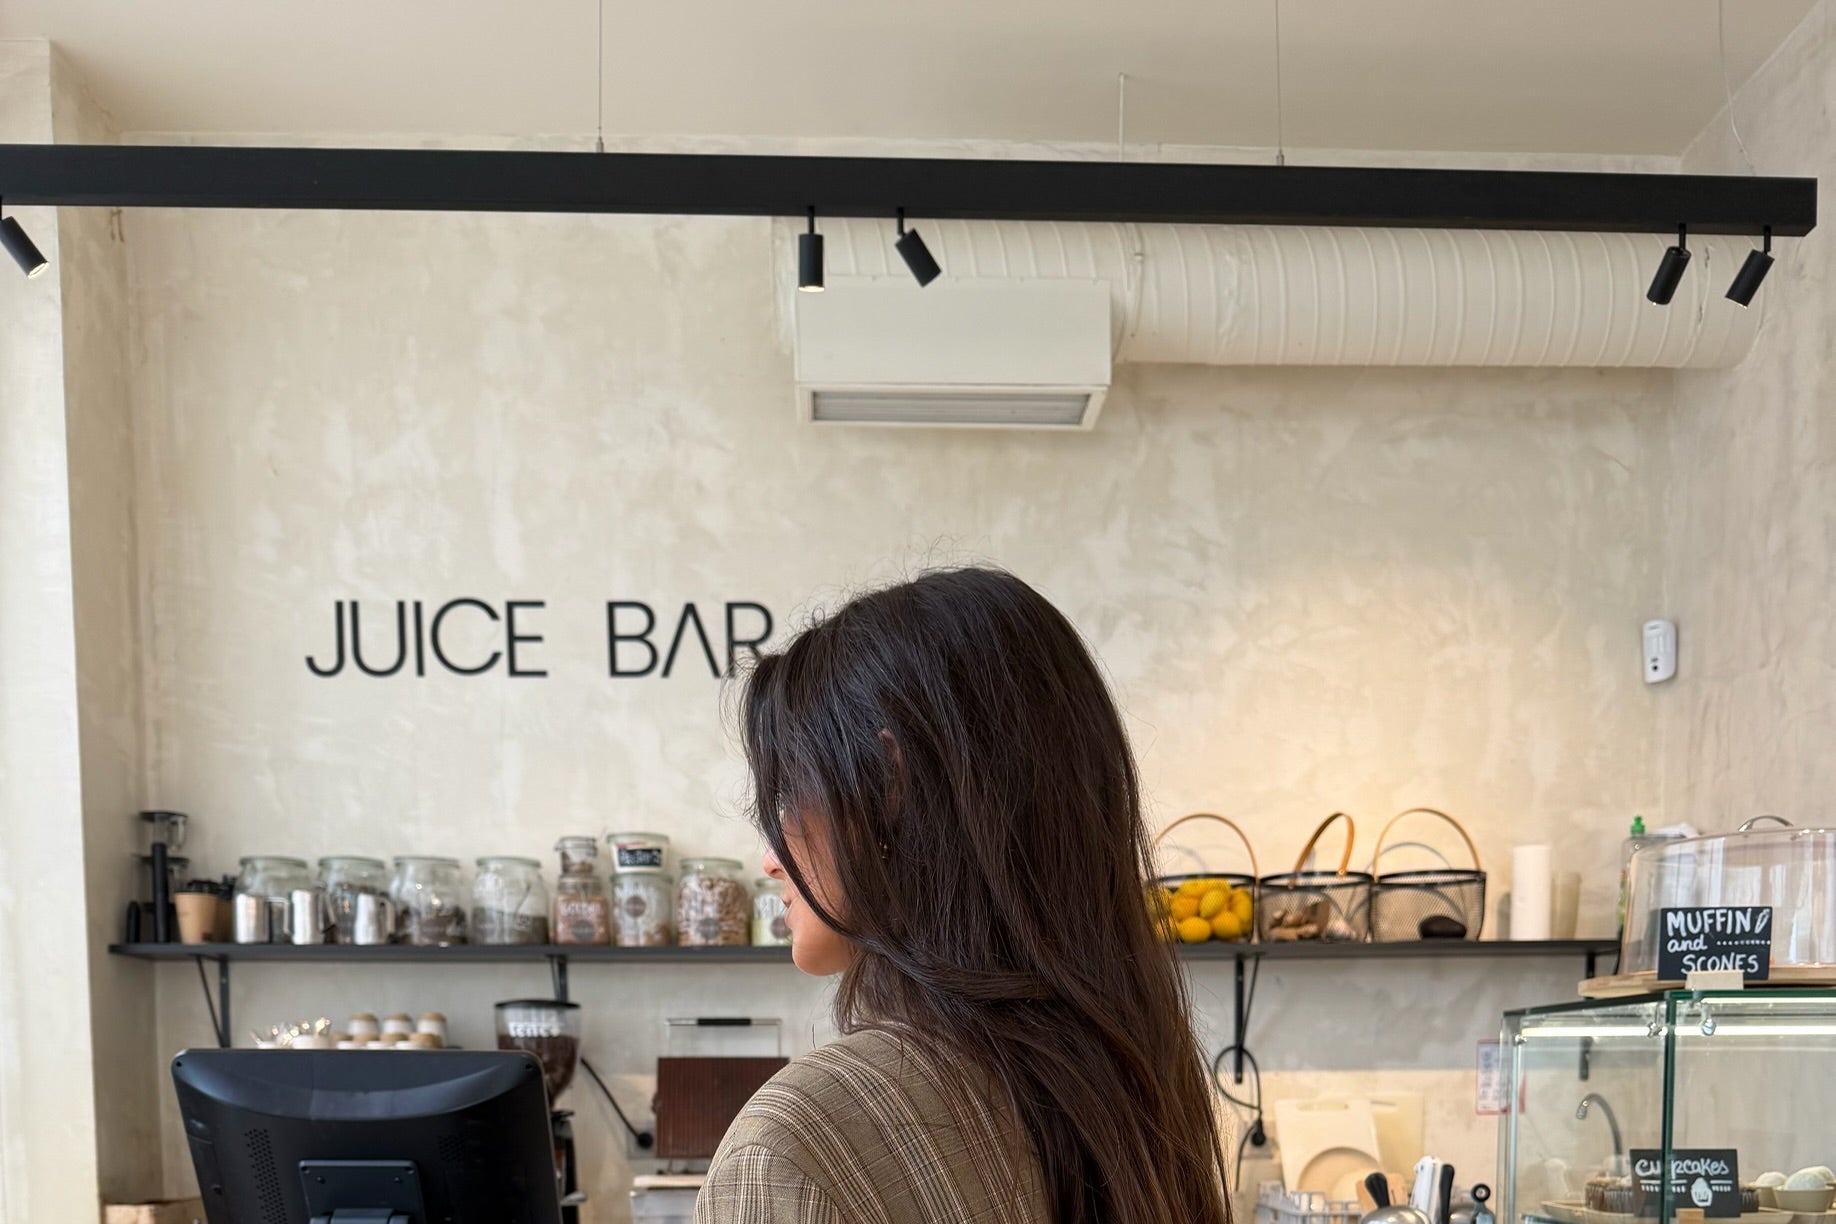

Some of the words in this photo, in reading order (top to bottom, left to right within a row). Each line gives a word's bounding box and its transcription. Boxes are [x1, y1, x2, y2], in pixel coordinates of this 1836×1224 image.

[305, 598, 548, 678] JUICE
[607, 601, 774, 678] BAR
[1666, 934, 1708, 953] and
[1681, 952, 1759, 974] SCONES
